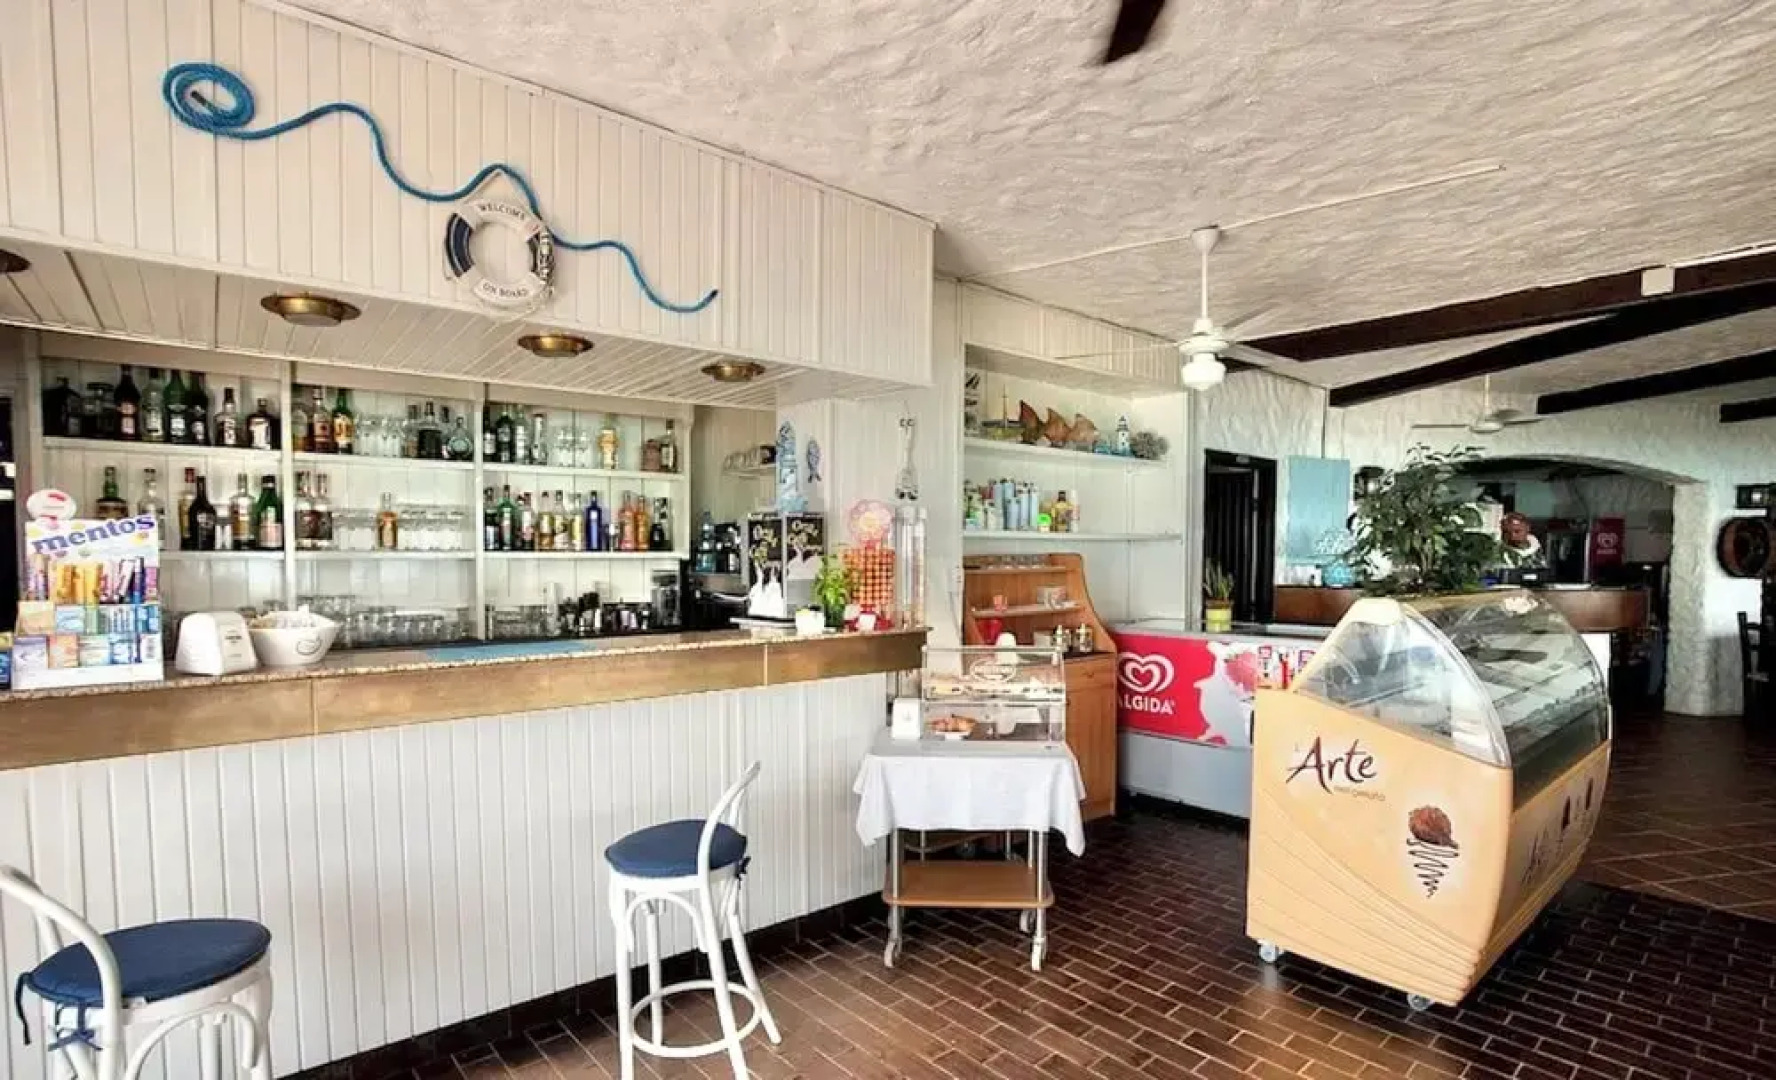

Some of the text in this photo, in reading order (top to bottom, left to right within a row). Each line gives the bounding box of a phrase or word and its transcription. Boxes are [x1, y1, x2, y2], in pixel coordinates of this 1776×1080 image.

[480, 202, 525, 220] WELCOME
[483, 282, 528, 298] ON BOARD
[32, 514, 156, 554] mentos
